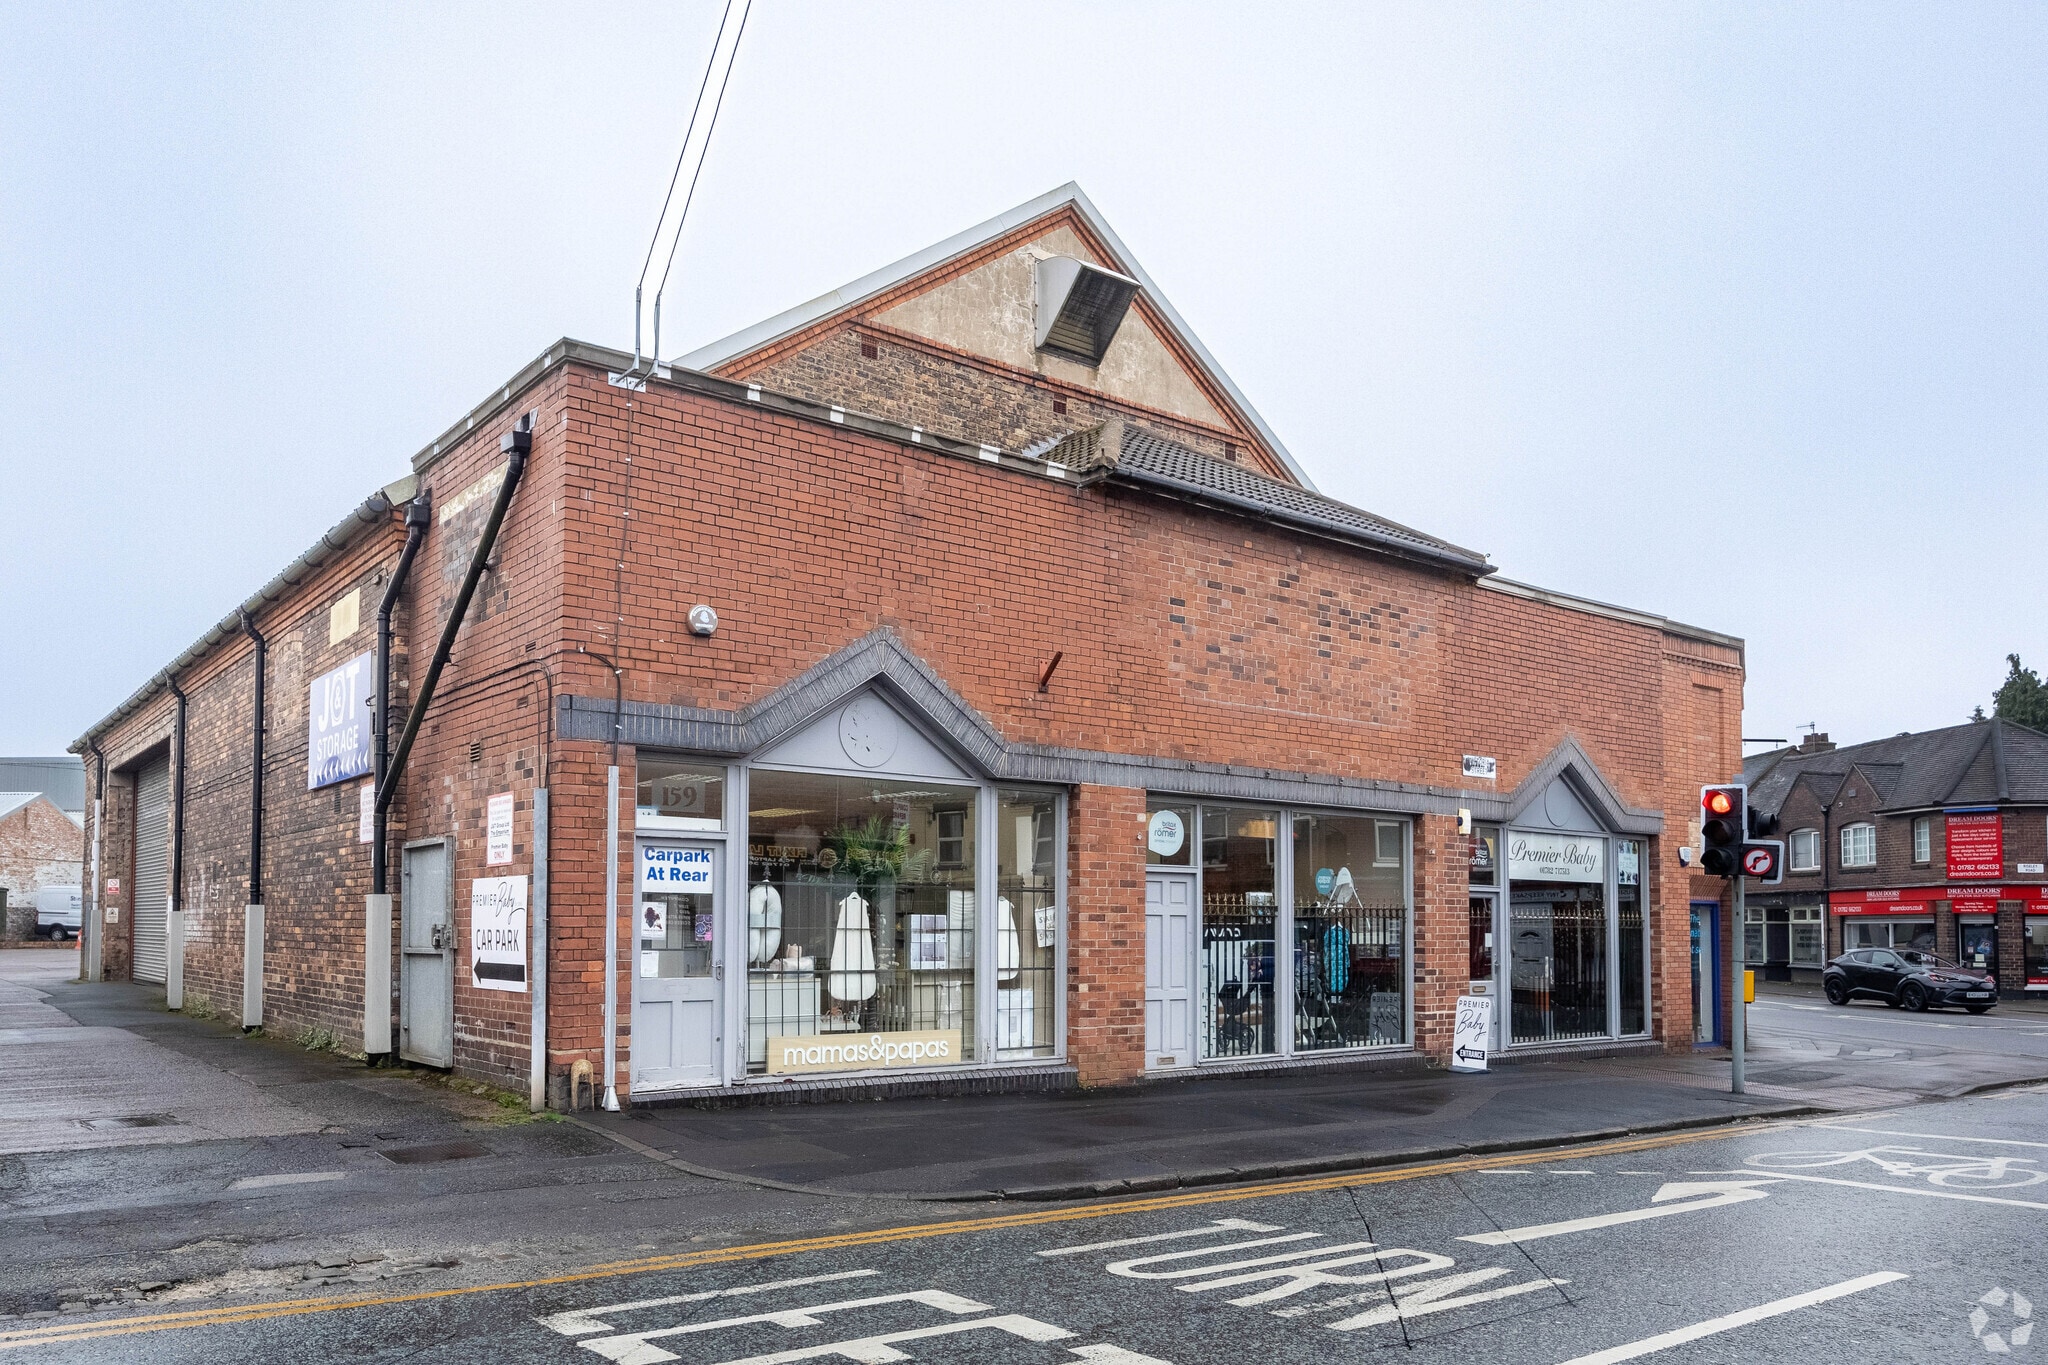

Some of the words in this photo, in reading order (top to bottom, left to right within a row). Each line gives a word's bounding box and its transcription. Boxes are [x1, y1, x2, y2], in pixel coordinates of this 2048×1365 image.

[316, 724, 359, 762] STORAGE
[662, 786, 697, 808] 159
[1154, 828, 1176, 838] römer
[644, 846, 711, 865] Carpark
[1509, 839, 1561, 863] Premier
[1563, 843, 1597, 873] Baby
[646, 866, 665, 881] At
[669, 867, 709, 882] Rear
[472, 893, 497, 907] PREMIER
[495, 881, 525, 925] Baby
[475, 928, 493, 951] CAR
[495, 928, 519, 952] PARK
[1458, 999, 1490, 1009] PREMIER
[1456, 1008, 1487, 1042] Baby
[783, 1034, 949, 1067] mamas&papas
[1459, 1049, 1484, 1060] ENTRANCE
[1036, 1218, 1571, 1331] TURN
